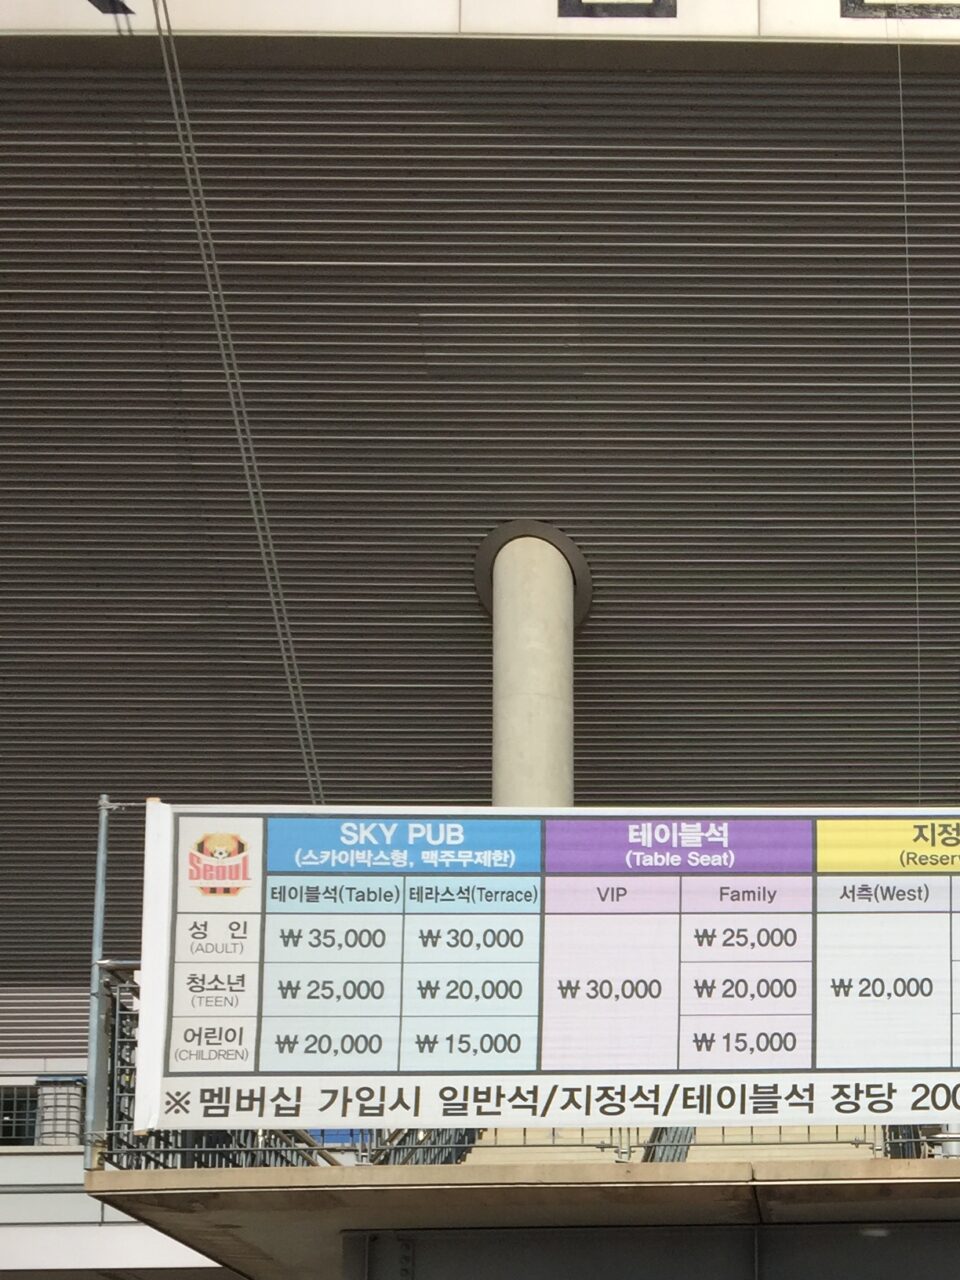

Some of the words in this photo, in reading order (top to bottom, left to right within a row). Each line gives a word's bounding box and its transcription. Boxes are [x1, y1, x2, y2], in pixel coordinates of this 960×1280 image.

[340, 823, 398, 847] SKY
[408, 823, 465, 845] PUB
[627, 822, 730, 848] 테이블석
[295, 848, 413, 867] (스카이박스형,
[420, 848, 516, 869] 맥주무제한)
[626, 850, 681, 868] (Table
[688, 850, 734, 868] Seat)
[268, 882, 402, 906] 테이블석(Table)
[407, 882, 539, 906] 테라스석(Terrace)
[597, 887, 627, 902] VIP
[720, 887, 777, 903] Family
[840, 884, 929, 903] 서측(West)
[190, 942, 243, 954] (ADULT)
[187, 974, 245, 992] 청소년
[191, 995, 238, 1008] (TEEN)
[184, 1027, 243, 1046] 어린이
[175, 1048, 248, 1061] (CHILDREN)
[319, 1086, 420, 1117] 가입시
[439, 1083, 814, 1117] 일반석/지정석/테이블석
[831, 1083, 897, 1113] 장당
